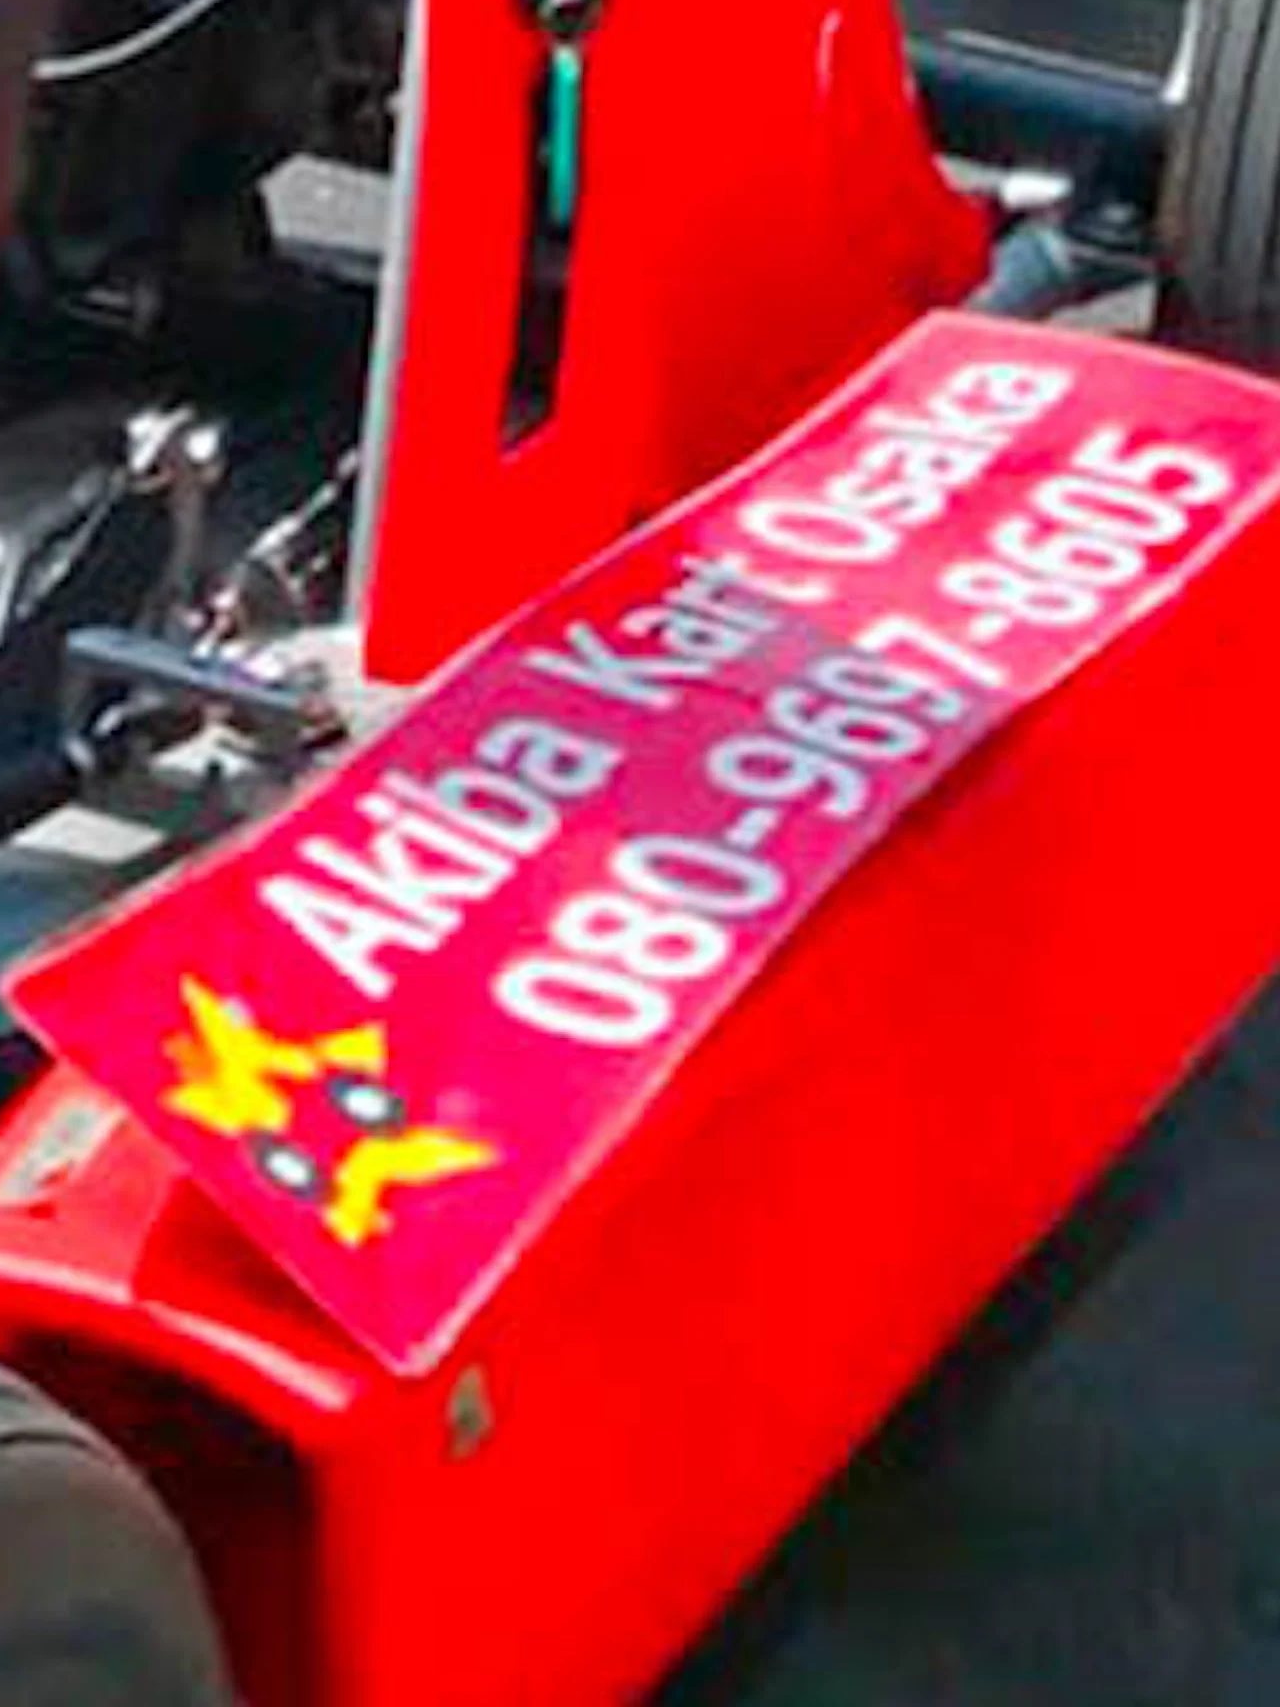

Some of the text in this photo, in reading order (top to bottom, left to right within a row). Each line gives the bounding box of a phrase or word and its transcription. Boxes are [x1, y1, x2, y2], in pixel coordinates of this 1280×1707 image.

[257, 361, 1074, 1000] Akiba Kart Osaka
[490, 425, 1234, 1049] 080-9697-8605
